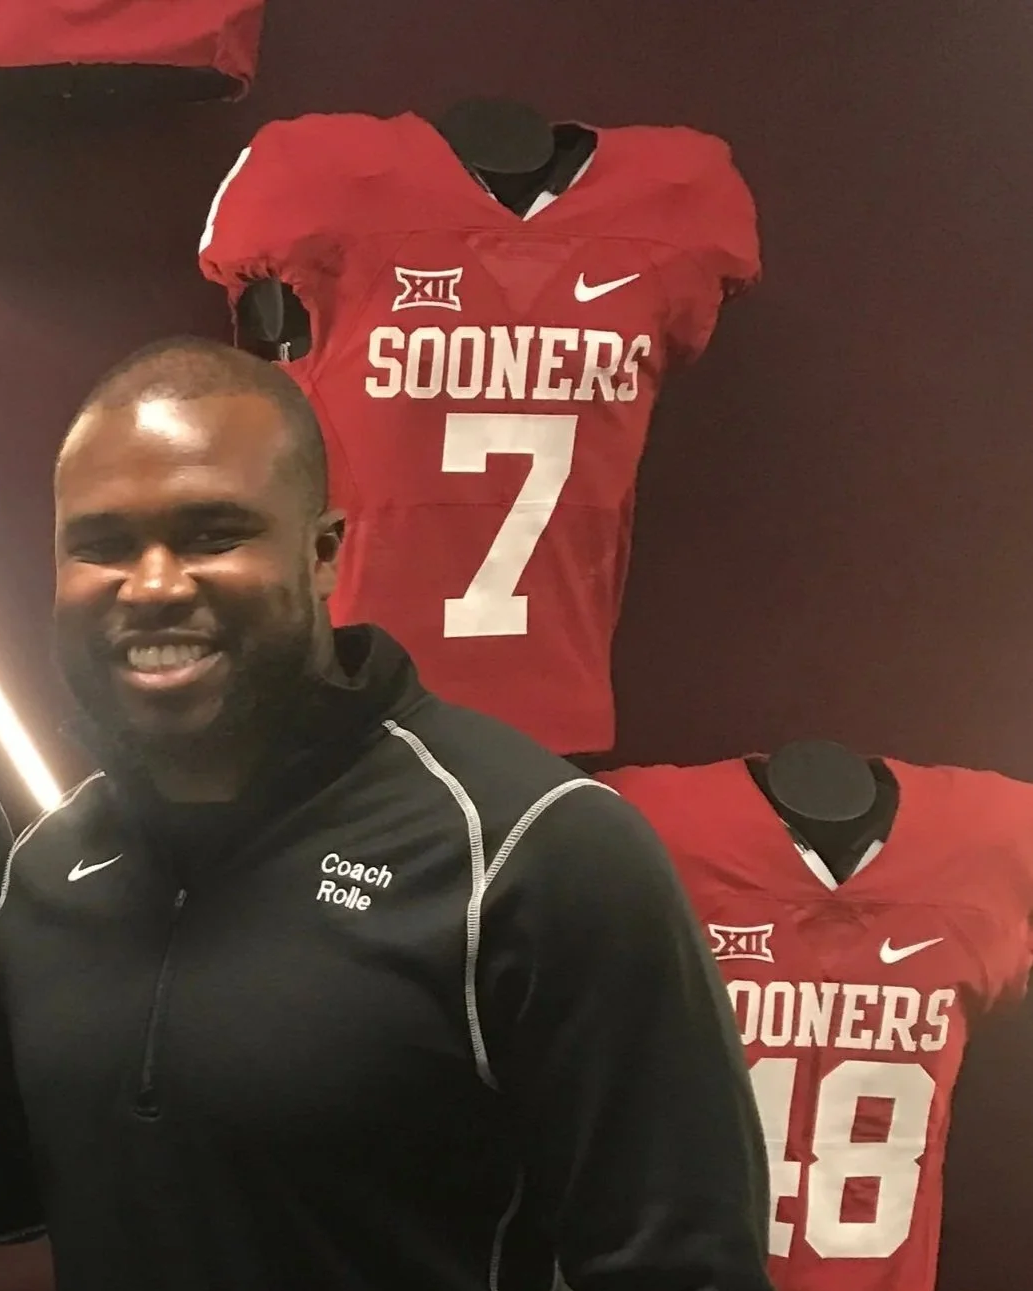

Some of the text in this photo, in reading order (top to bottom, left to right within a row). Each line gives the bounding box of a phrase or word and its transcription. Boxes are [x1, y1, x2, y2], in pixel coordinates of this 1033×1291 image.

[365, 325, 651, 401] SOONERS
[441, 412, 579, 638] 7
[316, 880, 371, 911] Rolle
[321, 853, 393, 888] Coach
[726, 980, 956, 1052] OONERS
